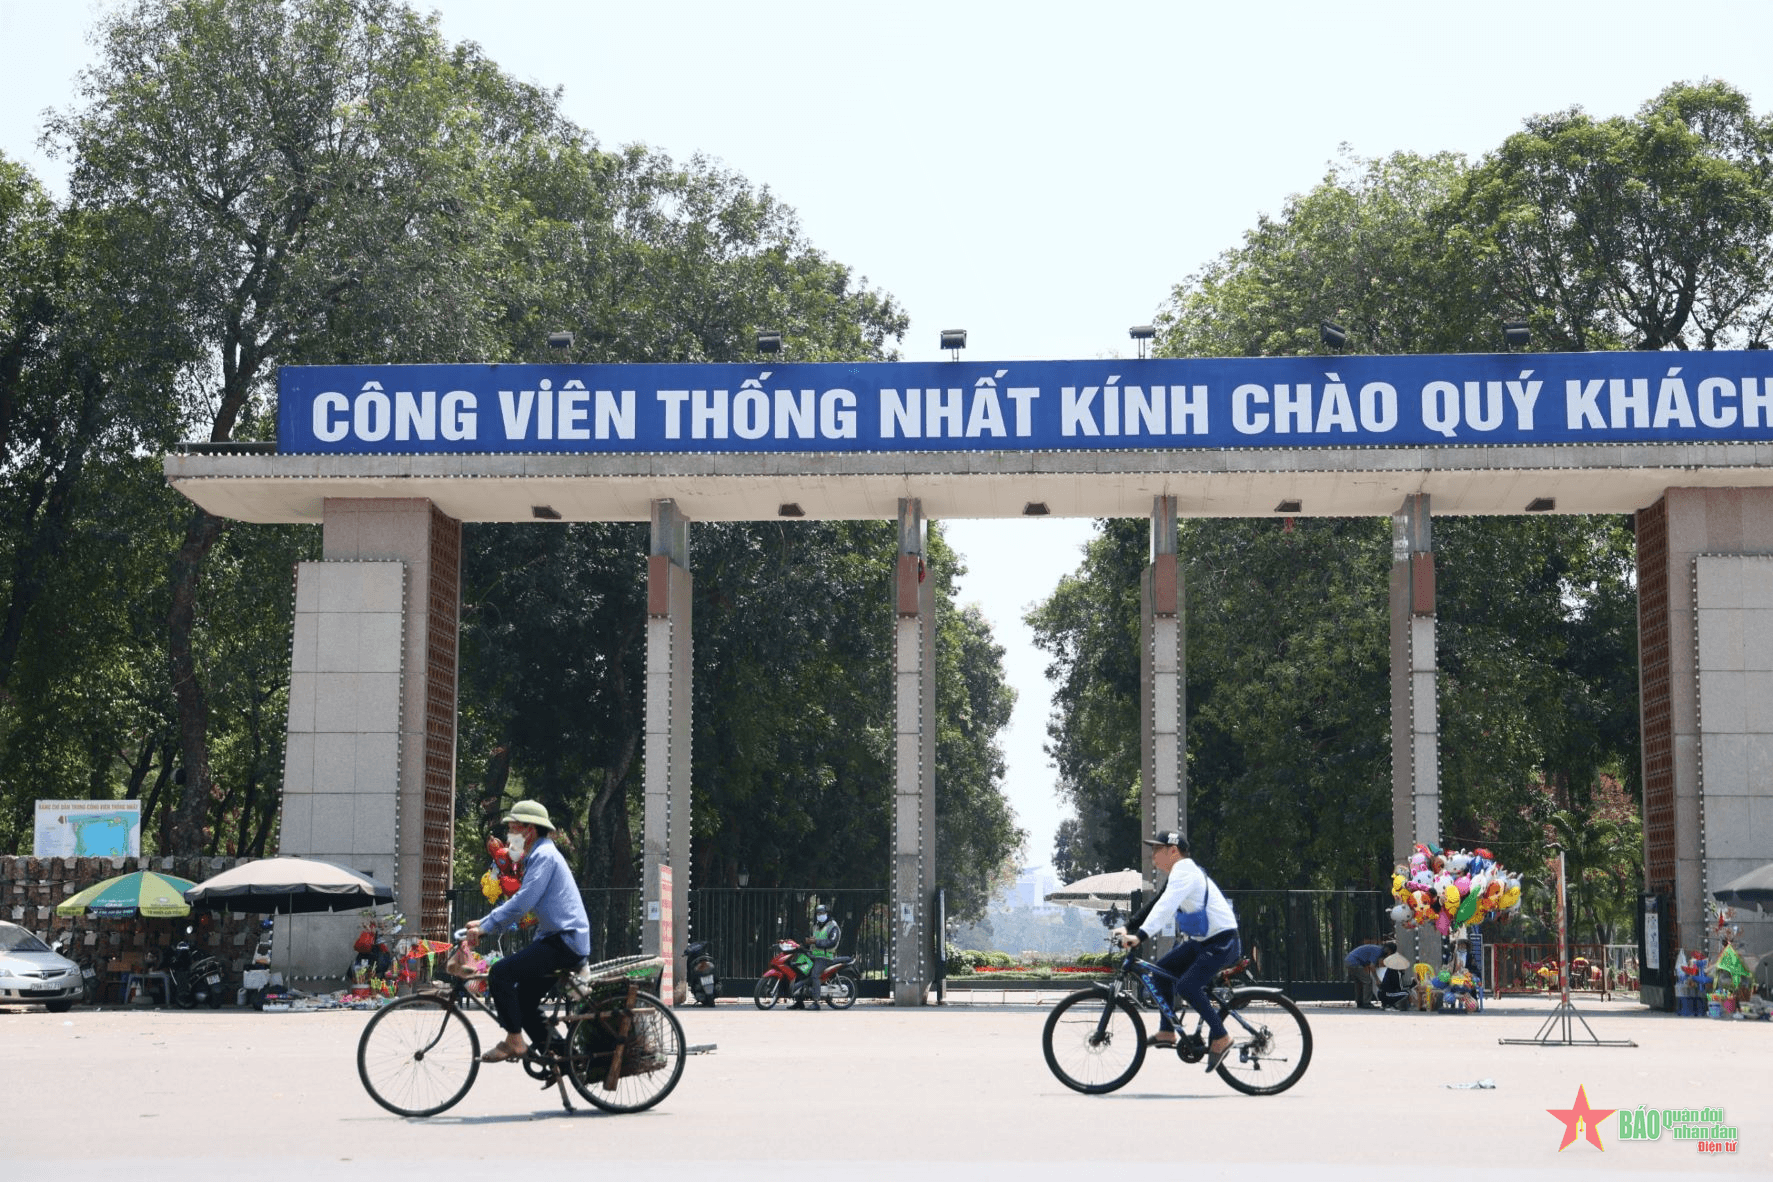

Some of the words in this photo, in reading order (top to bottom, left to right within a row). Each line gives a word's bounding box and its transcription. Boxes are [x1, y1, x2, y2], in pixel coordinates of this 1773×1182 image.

[312, 380, 478, 442] CÔNG
[656, 371, 857, 440] THỐNG
[879, 369, 1040, 439] NHẤT
[1061, 375, 1209, 437] KÍNH
[1231, 372, 1398, 435] CHÀO
[1421, 369, 1544, 438] QUÝ
[1565, 366, 1773, 430] KHÁCH
